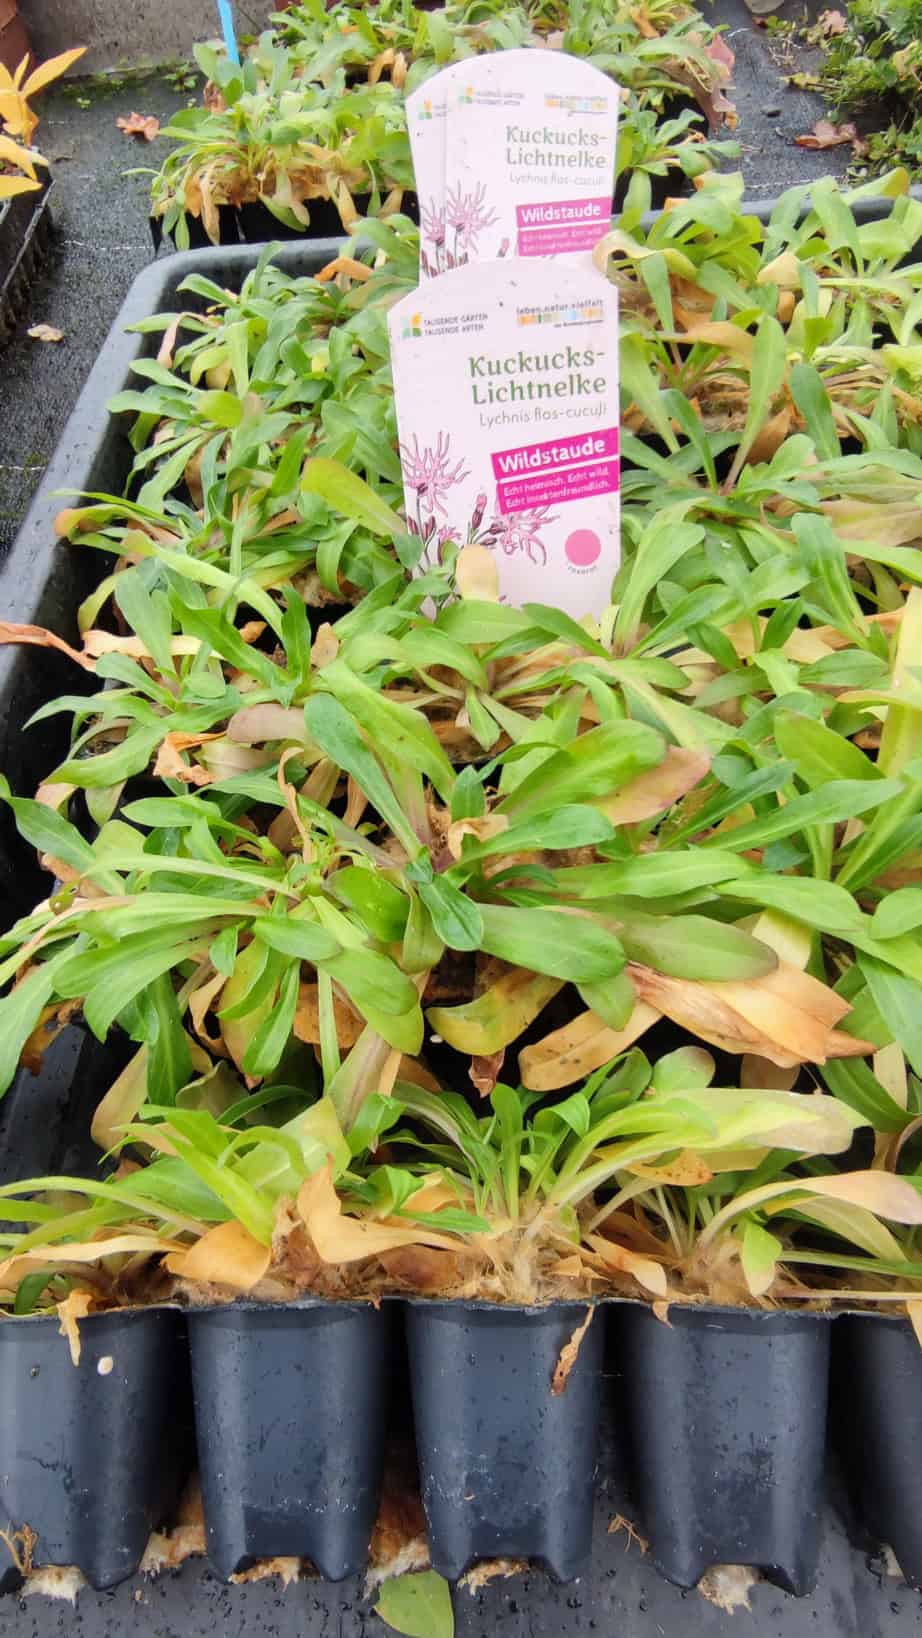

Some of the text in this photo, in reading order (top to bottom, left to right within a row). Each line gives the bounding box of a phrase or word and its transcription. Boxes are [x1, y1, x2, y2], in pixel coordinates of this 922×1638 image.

[506, 125, 608, 146] Kuckucks-
[506, 147, 606, 168] Lichtnelke
[521, 203, 601, 223] Wildstaude
[468, 346, 606, 378] Kuckucks-
[472, 374, 607, 405] Lichtnelke
[479, 409, 530, 430] Lychnis
[498, 437, 606, 473] Wildstaude
